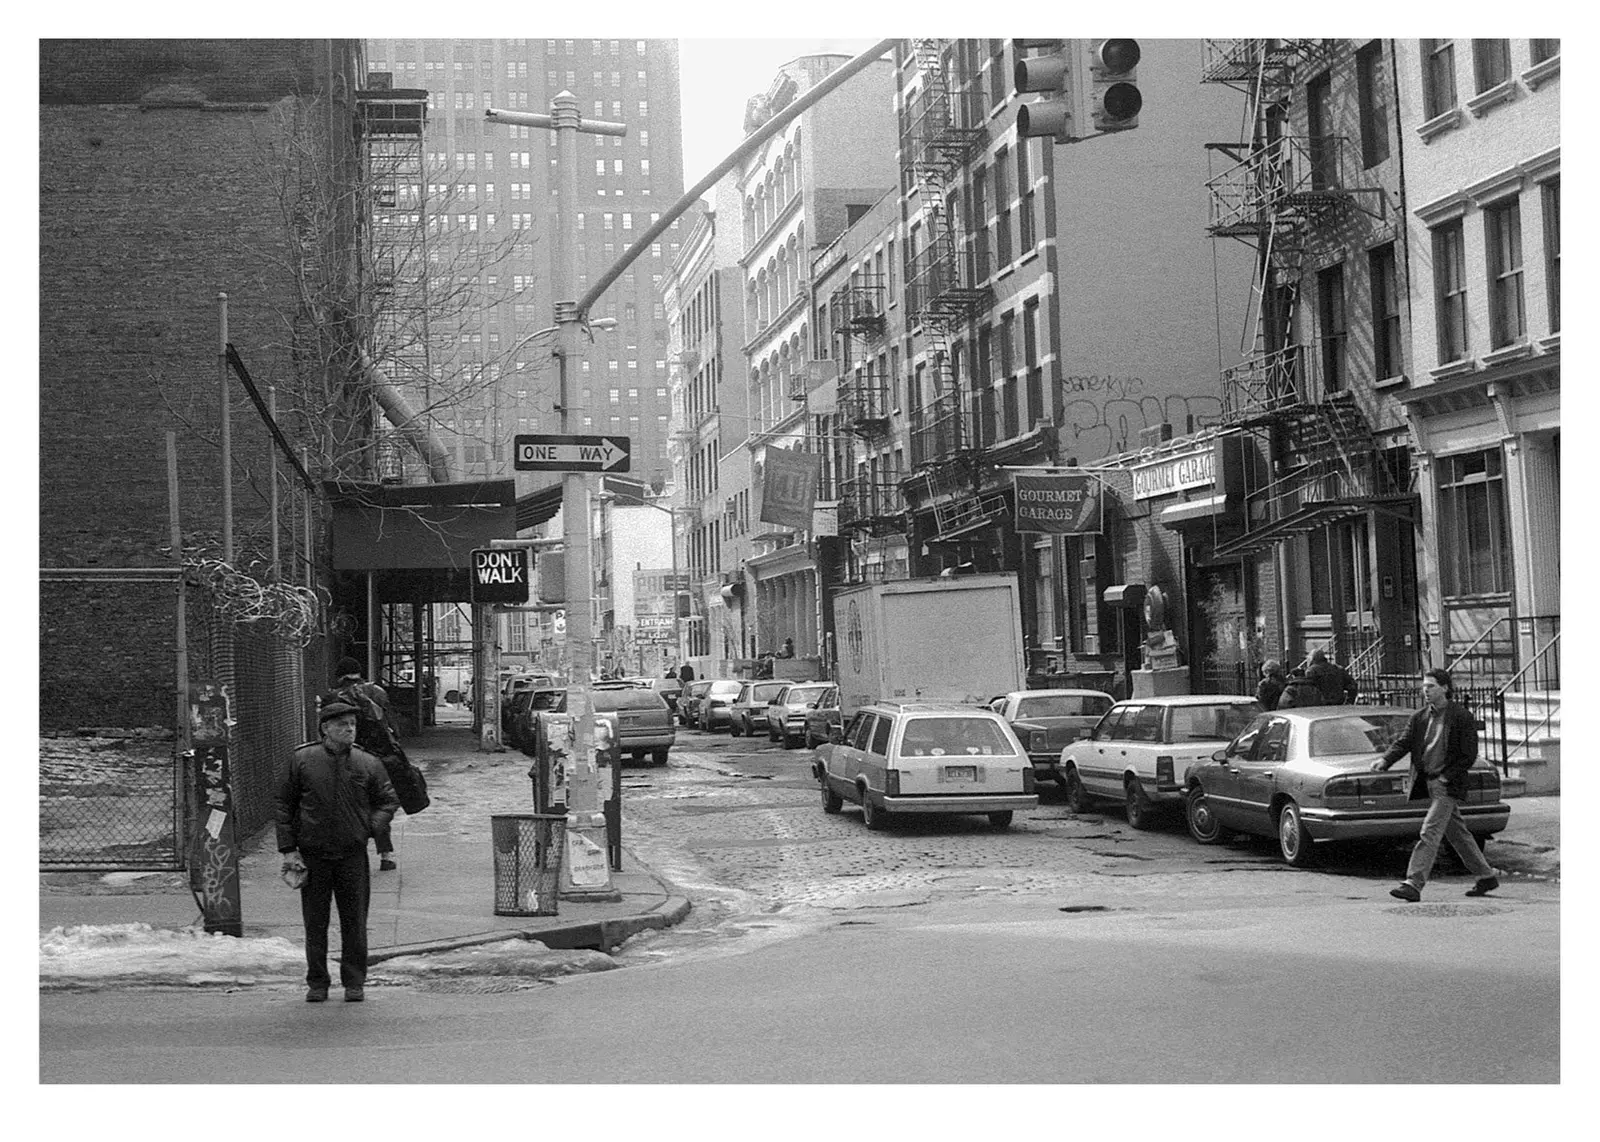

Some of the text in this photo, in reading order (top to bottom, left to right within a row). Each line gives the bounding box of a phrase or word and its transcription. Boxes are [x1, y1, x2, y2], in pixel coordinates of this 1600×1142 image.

[523, 446, 614, 461] ONE WAY
[1135, 465, 1175, 495] GOURMET
[1019, 489, 1083, 502] GOURMET
[1019, 507, 1073, 520] GARAGE
[476, 551, 522, 568] DONT
[477, 566, 524, 584] WALK
[640, 618, 676, 627] ENTRANC
